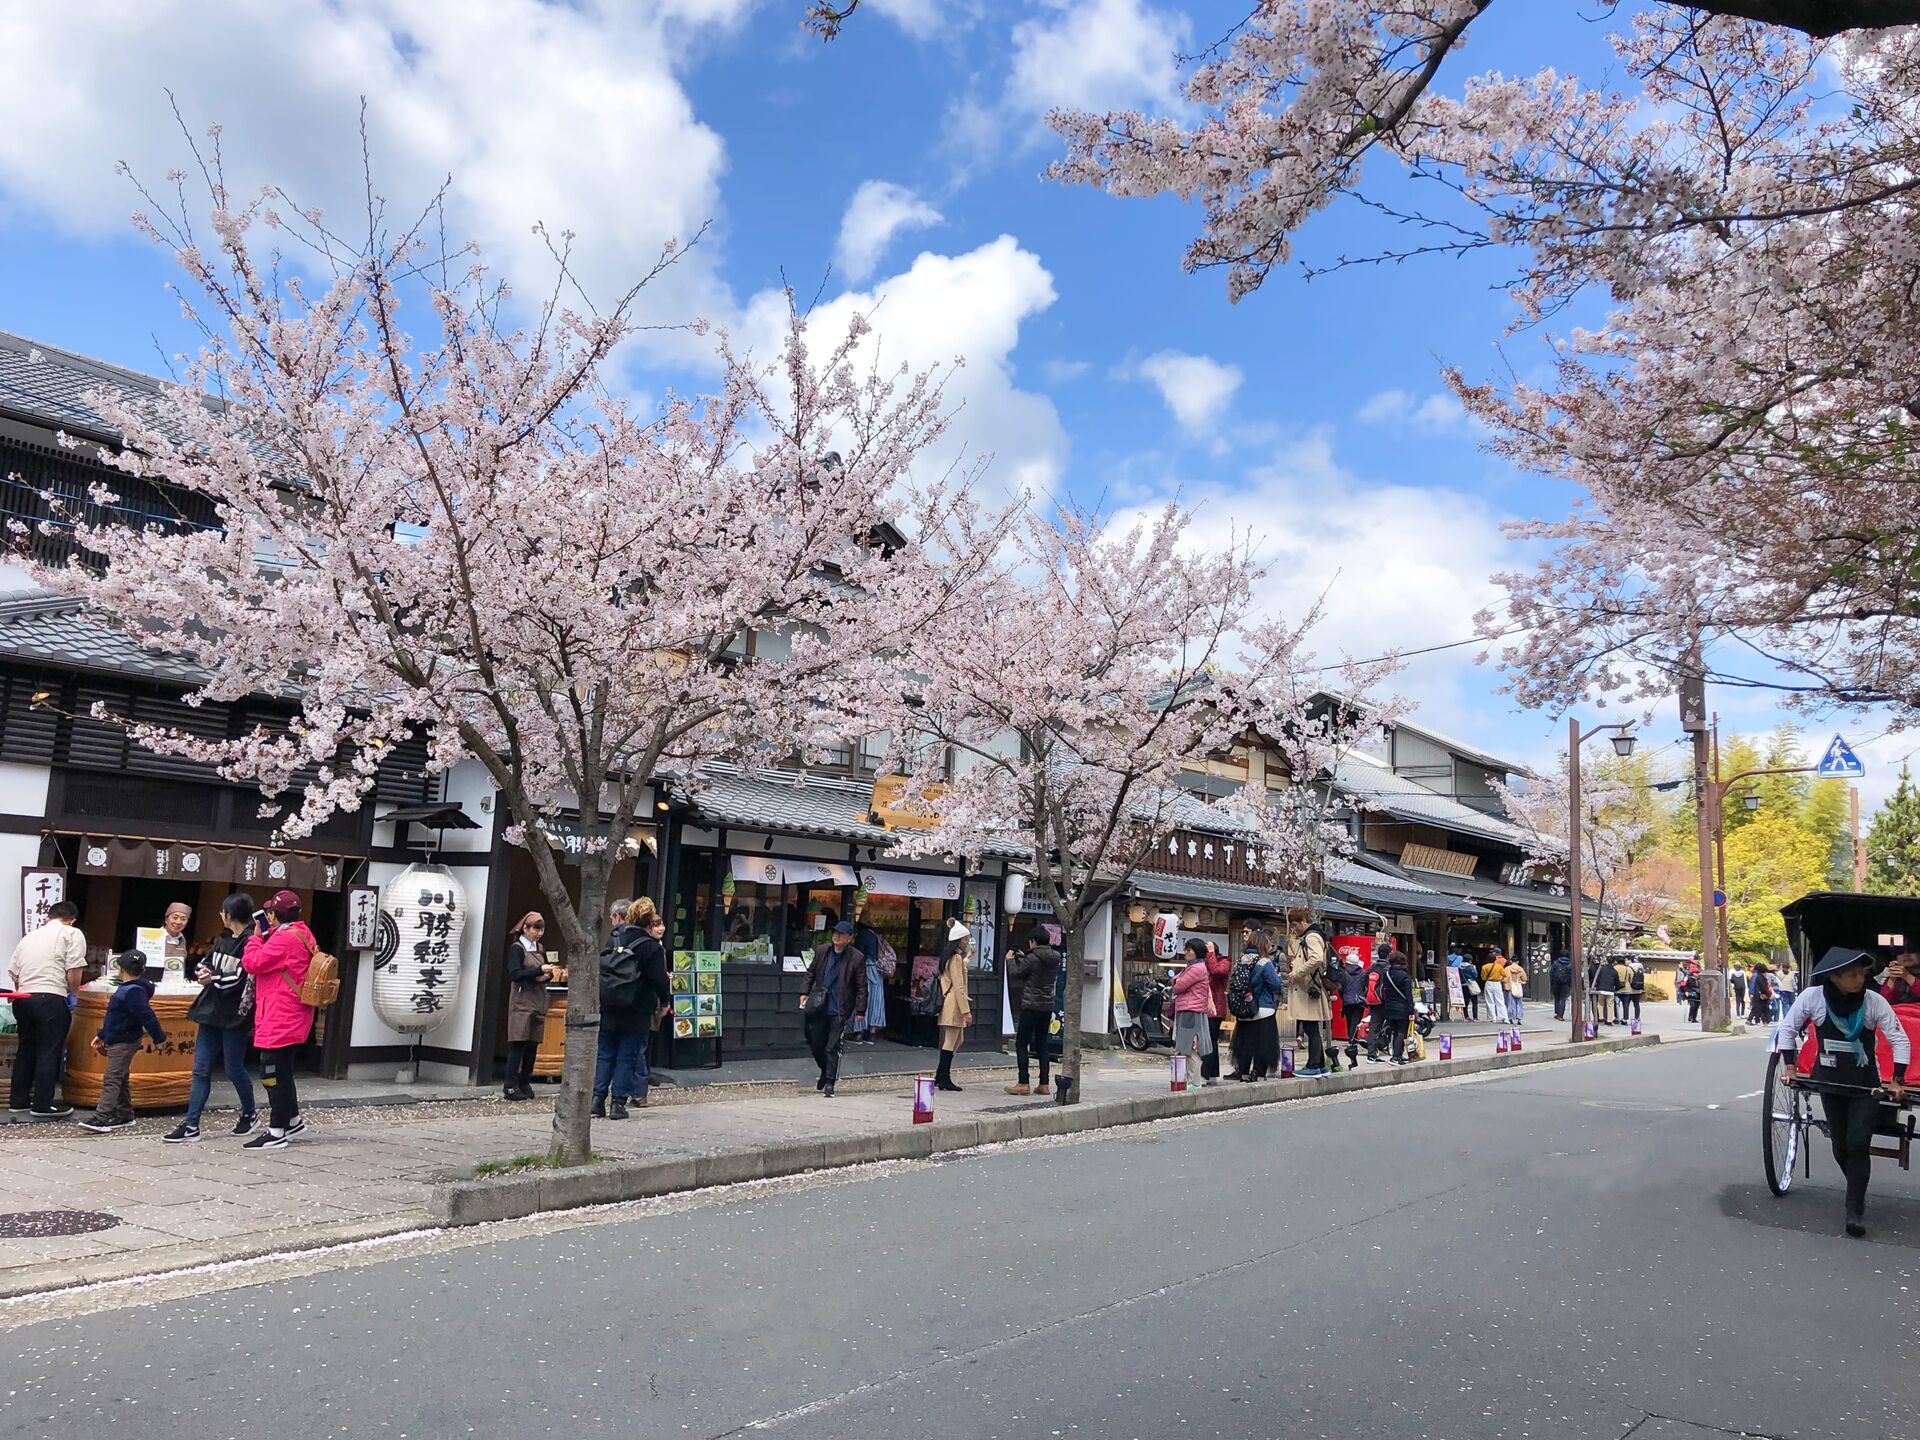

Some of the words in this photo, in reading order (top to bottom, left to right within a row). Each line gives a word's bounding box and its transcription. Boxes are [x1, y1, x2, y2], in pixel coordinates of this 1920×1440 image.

[357, 894, 369, 944] 千枚漬
[1163, 931, 1175, 953] そば
